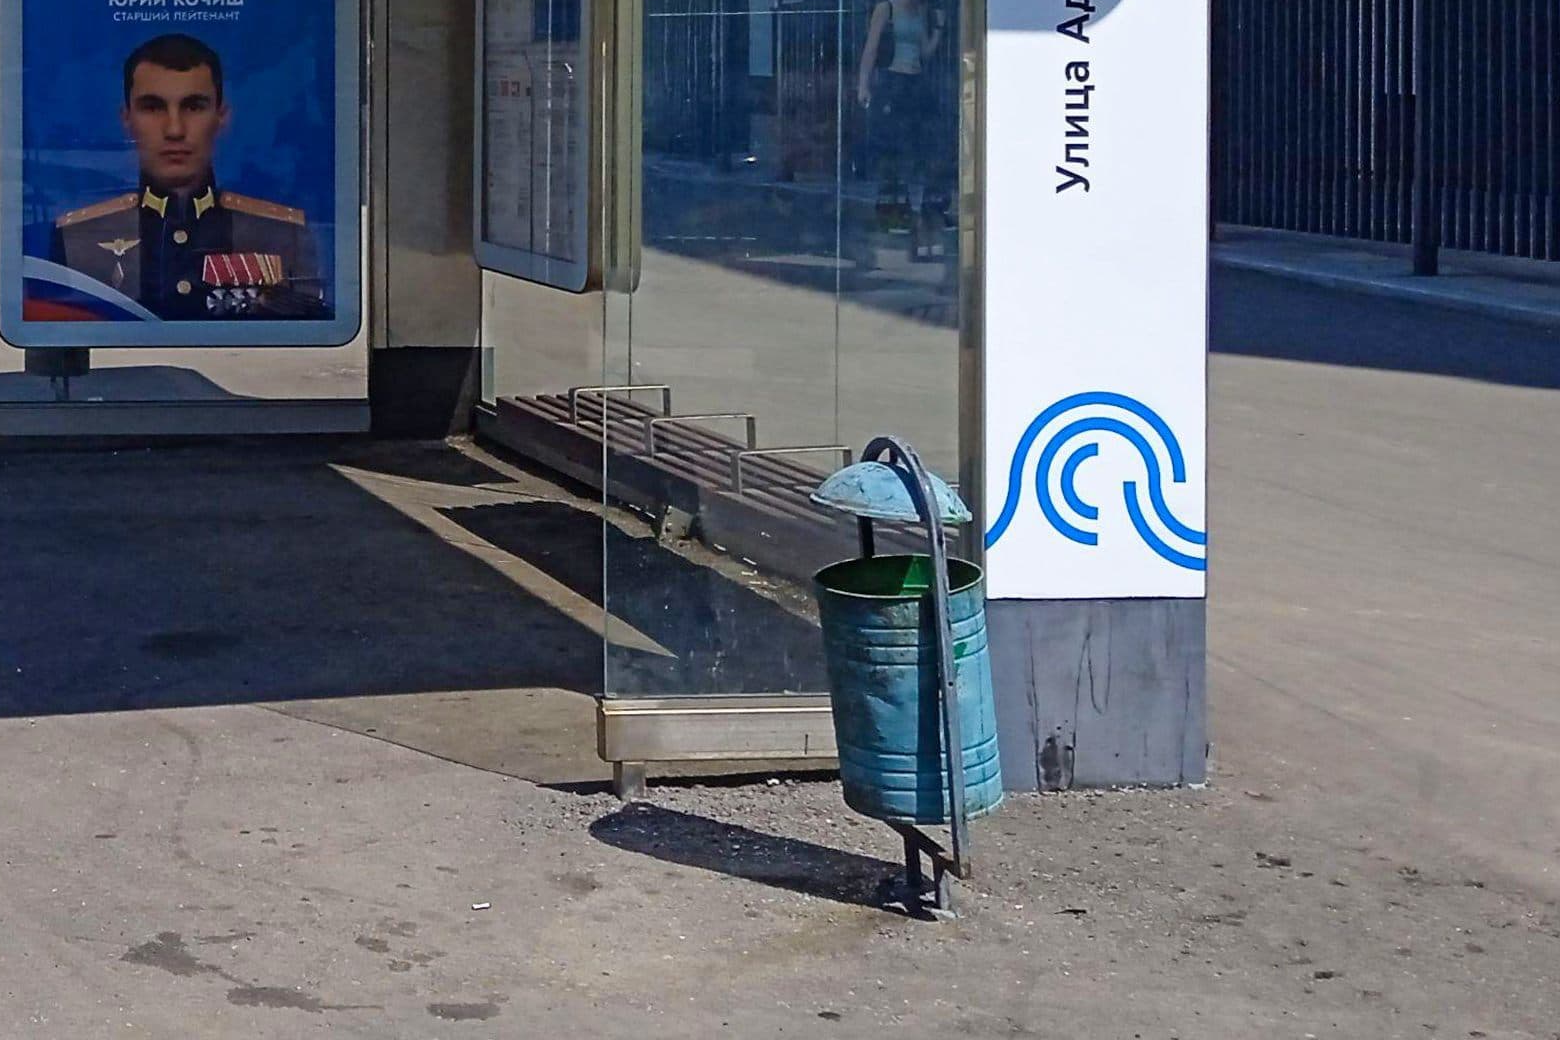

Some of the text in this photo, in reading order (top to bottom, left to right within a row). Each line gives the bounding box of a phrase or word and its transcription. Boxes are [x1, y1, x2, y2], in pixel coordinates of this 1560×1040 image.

[113, 9, 240, 21] СТАРШИЙ ЛЕЙТЕНАНТ
[1056, 61, 1096, 193] Улица
